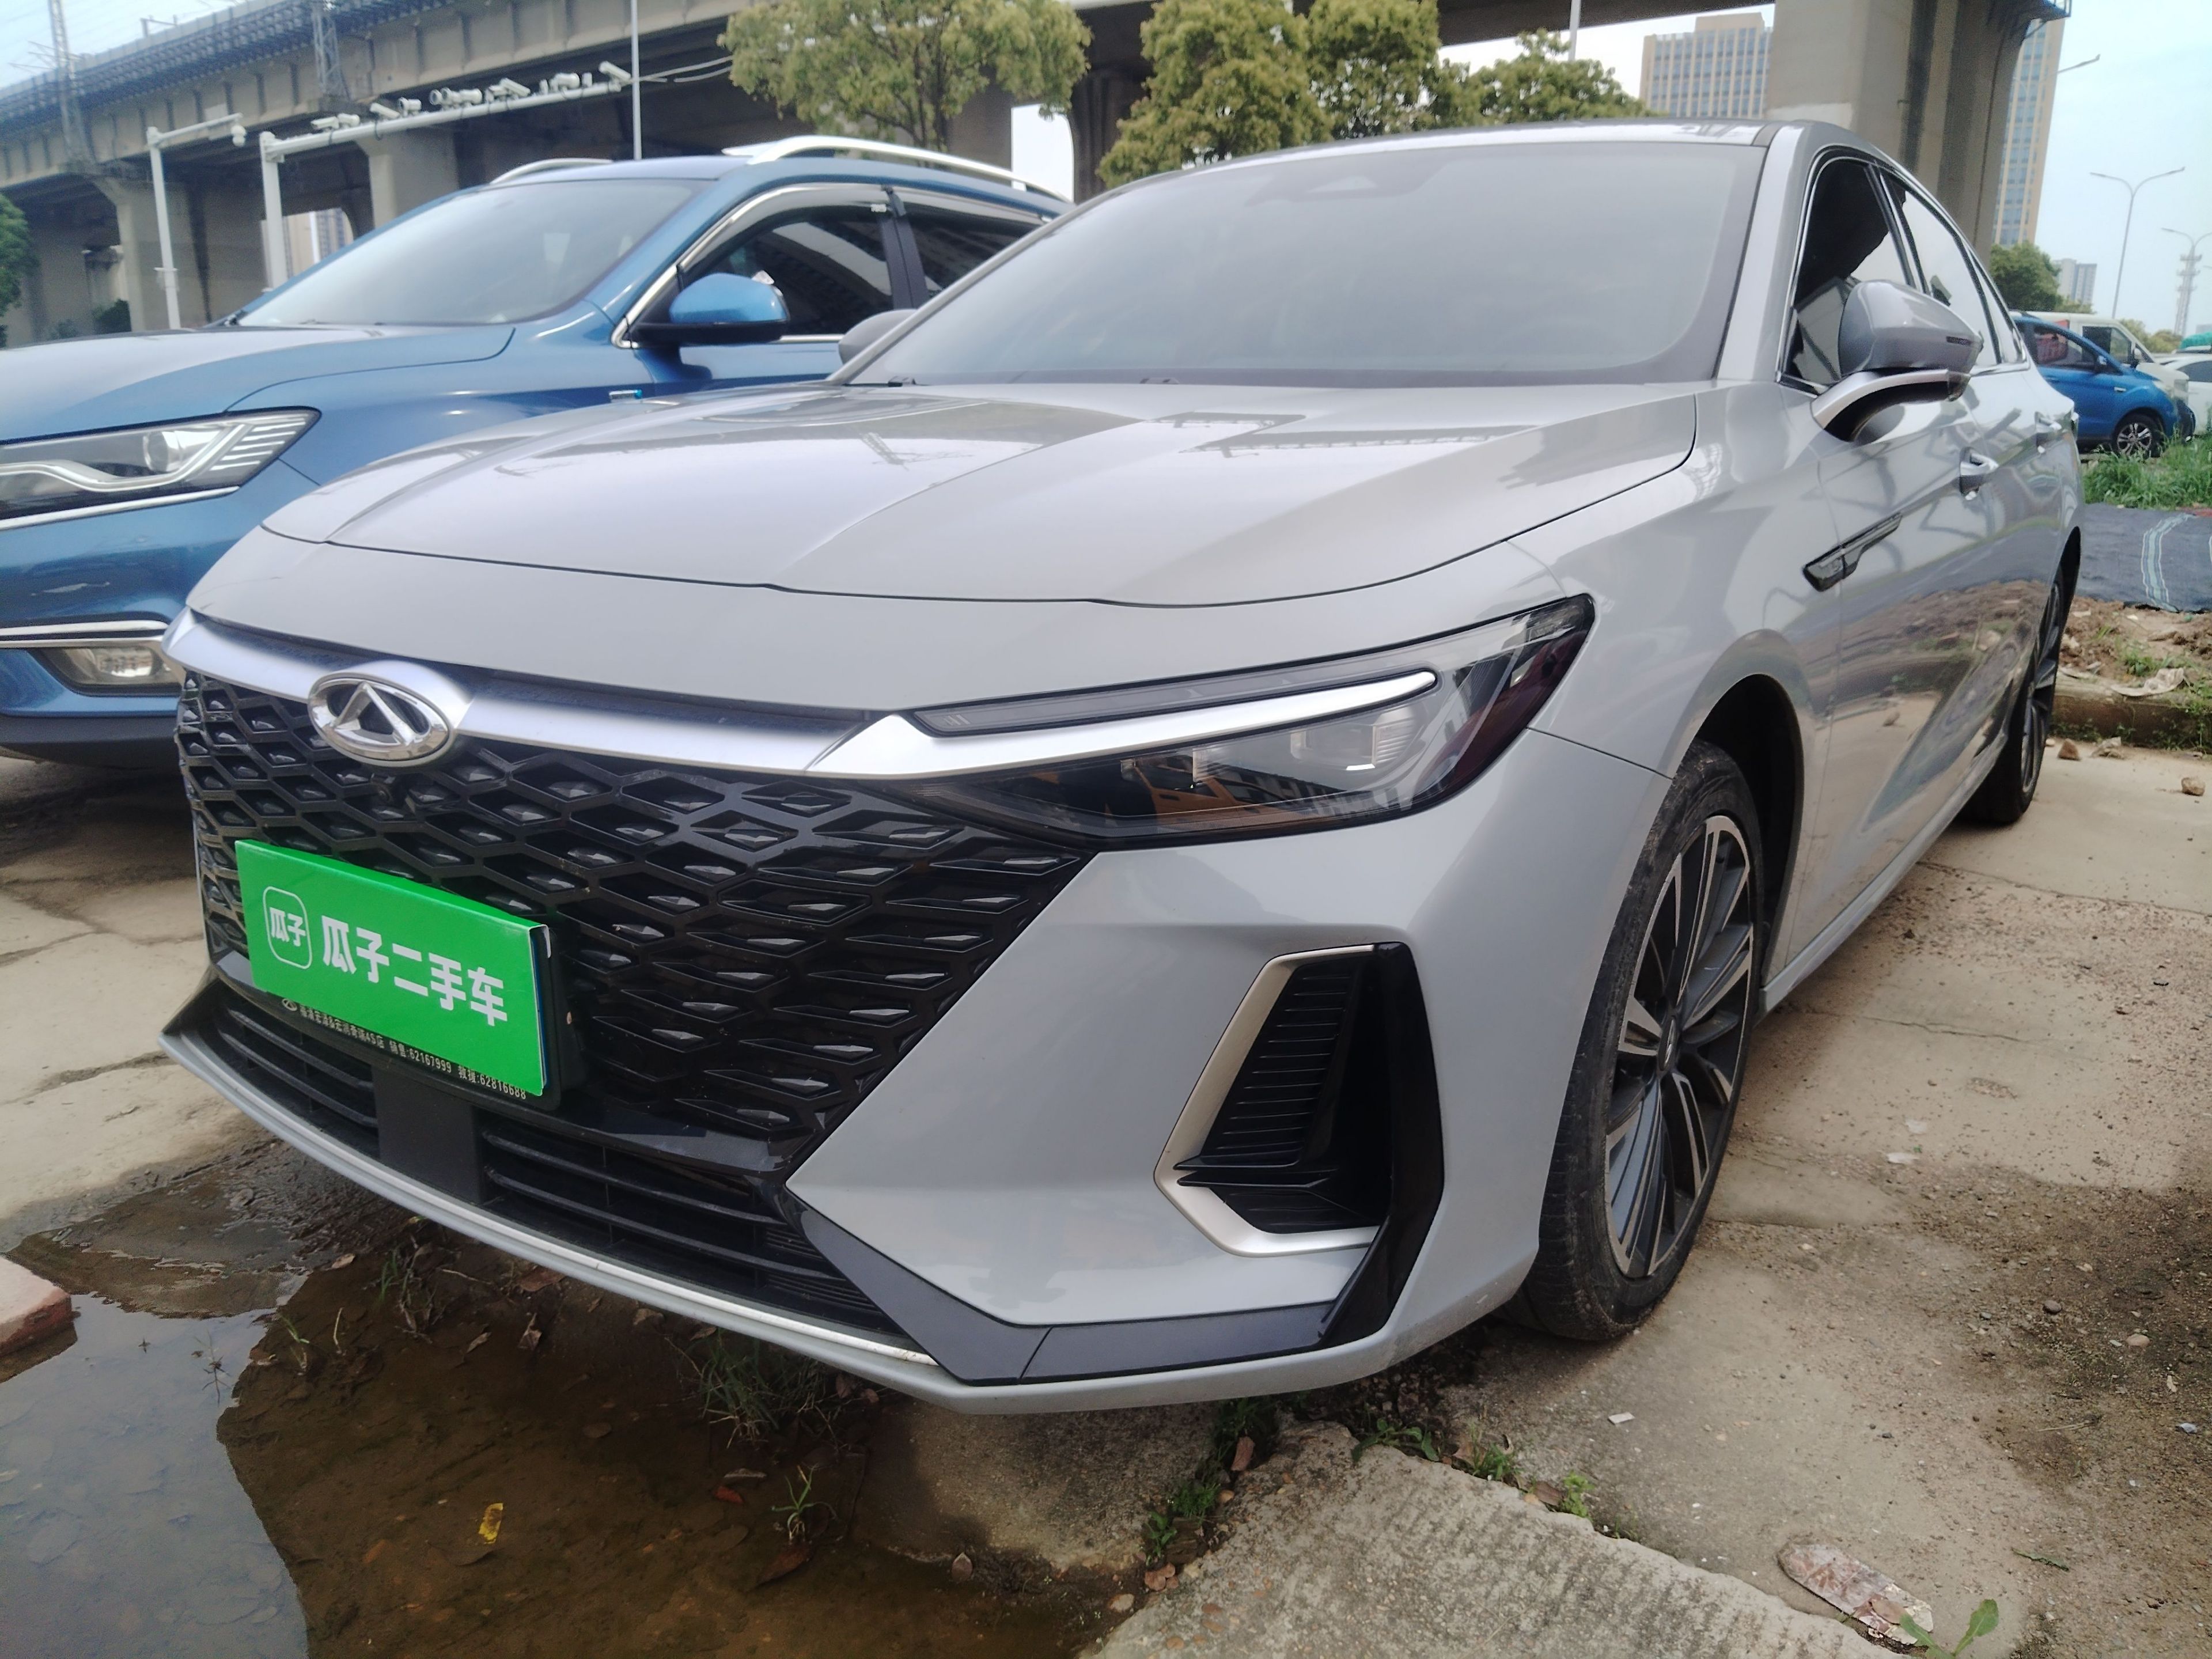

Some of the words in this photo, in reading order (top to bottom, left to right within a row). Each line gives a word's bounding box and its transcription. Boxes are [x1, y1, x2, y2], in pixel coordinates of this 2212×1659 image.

[270, 907, 306, 946] 瓜子
[321, 915, 507, 1027] 瓜子二手车
